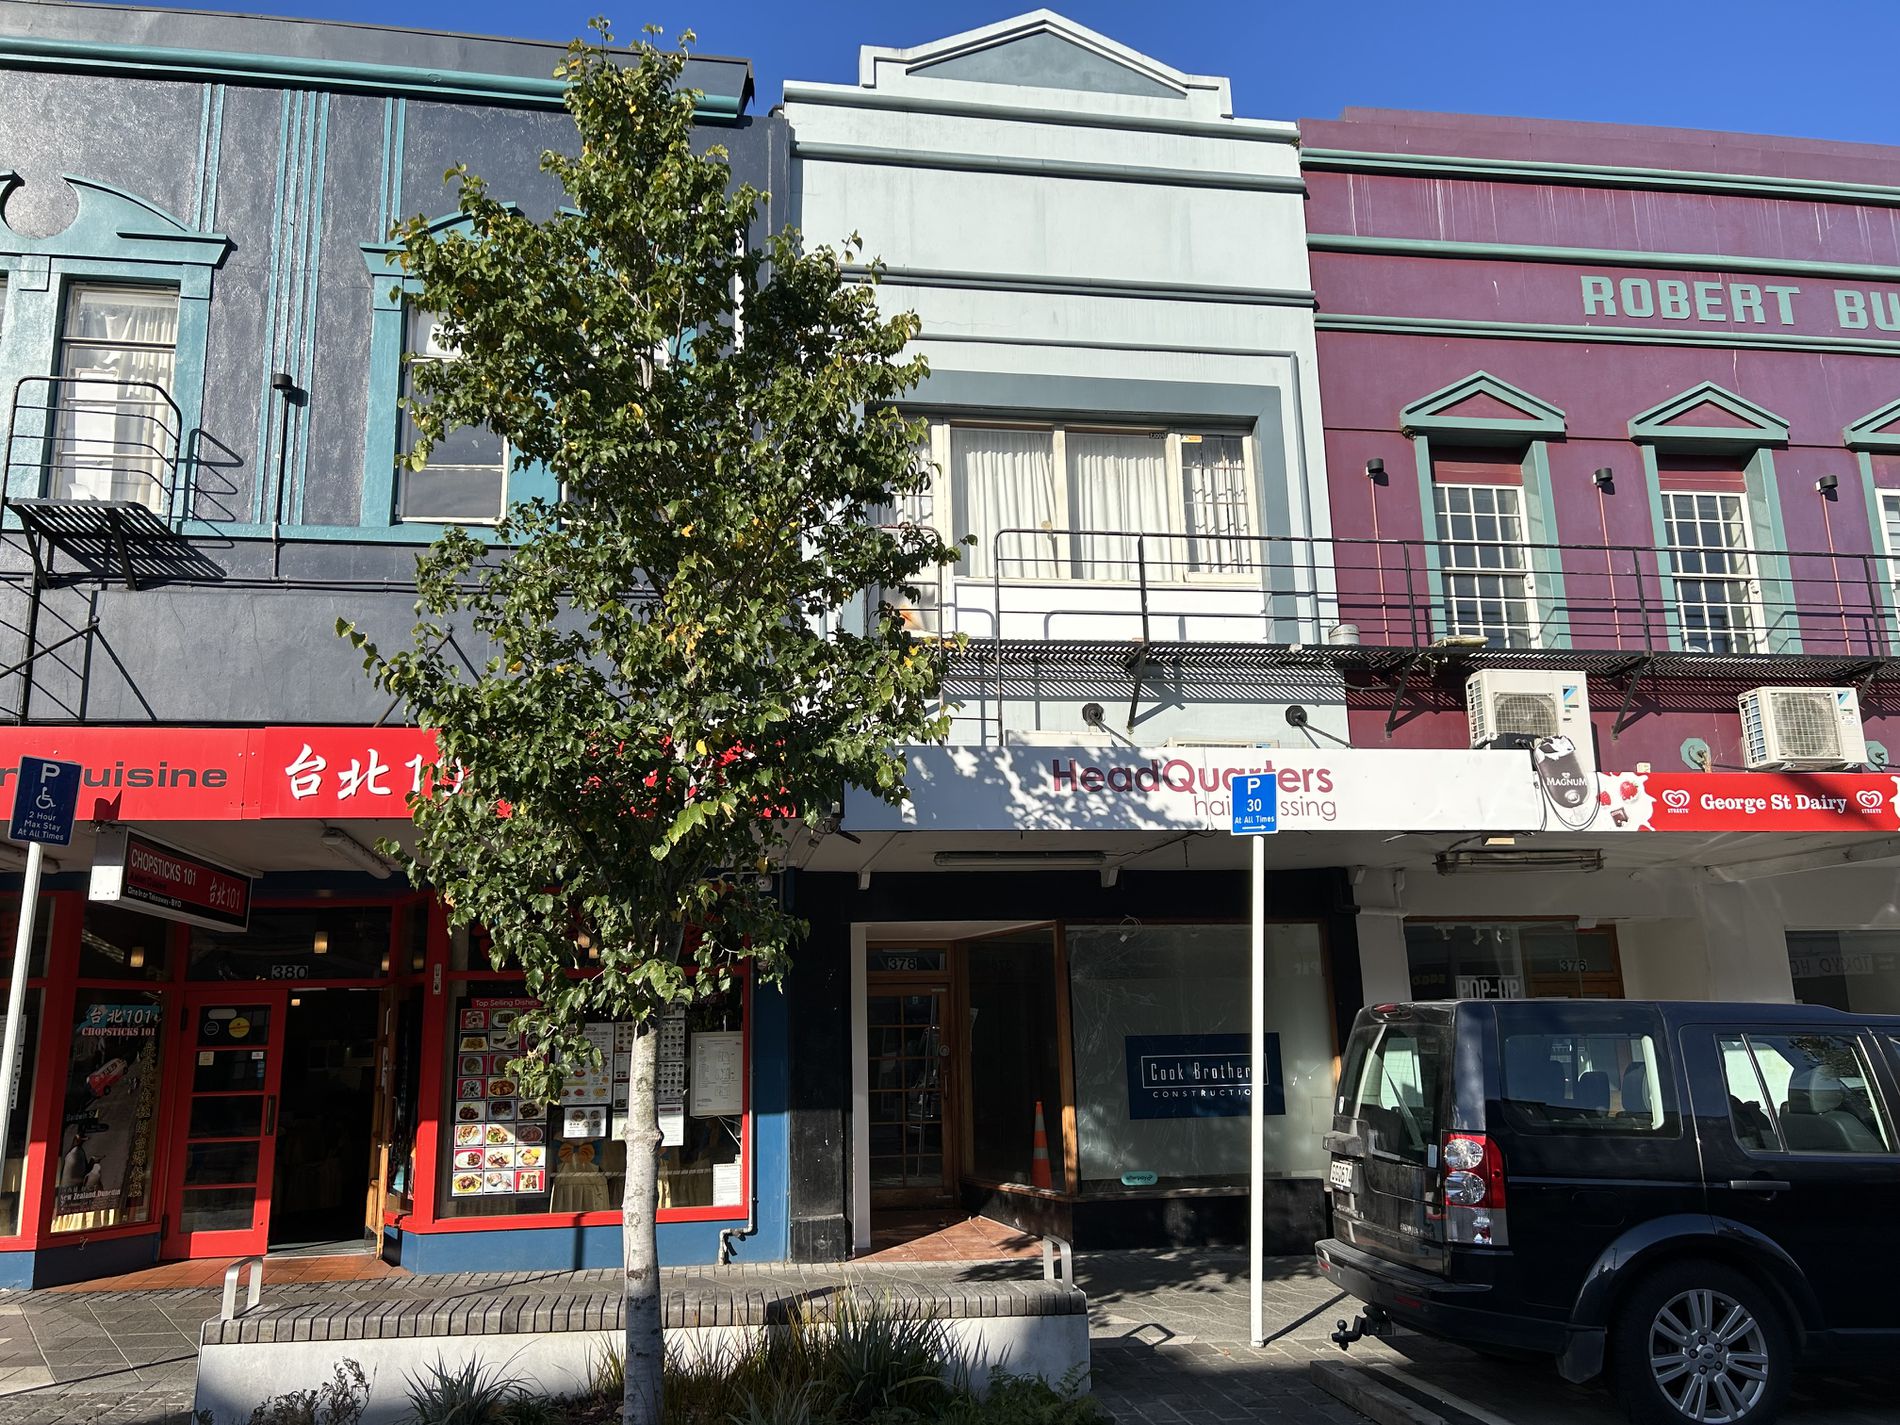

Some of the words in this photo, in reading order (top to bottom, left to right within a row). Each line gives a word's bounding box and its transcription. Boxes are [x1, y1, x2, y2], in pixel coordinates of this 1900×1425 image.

[1581, 275, 1800, 325] ROBERT
[40, 763, 60, 783] P
[83, 761, 227, 788] uisine
[1247, 777, 1261, 795] P
[1546, 777, 1588, 786] MAGNUM
[1194, 795, 1337, 821] haissing
[1247, 798, 1262, 812] 30
[1700, 793, 1767, 813] George
[1770, 793, 1792, 810] St
[1795, 794, 1847, 813] Dairy
[29, 811, 35, 819] 2
[37, 812, 56, 821] Hour
[1234, 816, 1242, 824] At
[1244, 815, 1254, 824] All
[1256, 814, 1275, 823] Times
[24, 820, 40, 829] Max
[43, 822, 61, 832] Stay
[17, 828, 26, 836] At
[28, 830, 40, 838] All
[42, 831, 64, 840] Times
[131, 848, 181, 882] CHOPSTICKS
[183, 868, 197, 886] 101
[889, 958, 917, 970] 378
[1560, 960, 1588, 972] 376
[273, 965, 308, 979] 380
[1459, 979, 1520, 999] POP-UP
[475, 1000, 489, 1008] Top
[490, 999, 513, 1008] Selling
[90, 1006, 152, 1024] 台北101
[82, 1027, 138, 1036] CHOPSTICKS
[140, 1027, 155, 1036] 101
[1150, 1062, 1184, 1081] Cook
[1193, 1061, 1252, 1080] Brother
[1152, 1088, 1252, 1098] CONSTRUCTIO
